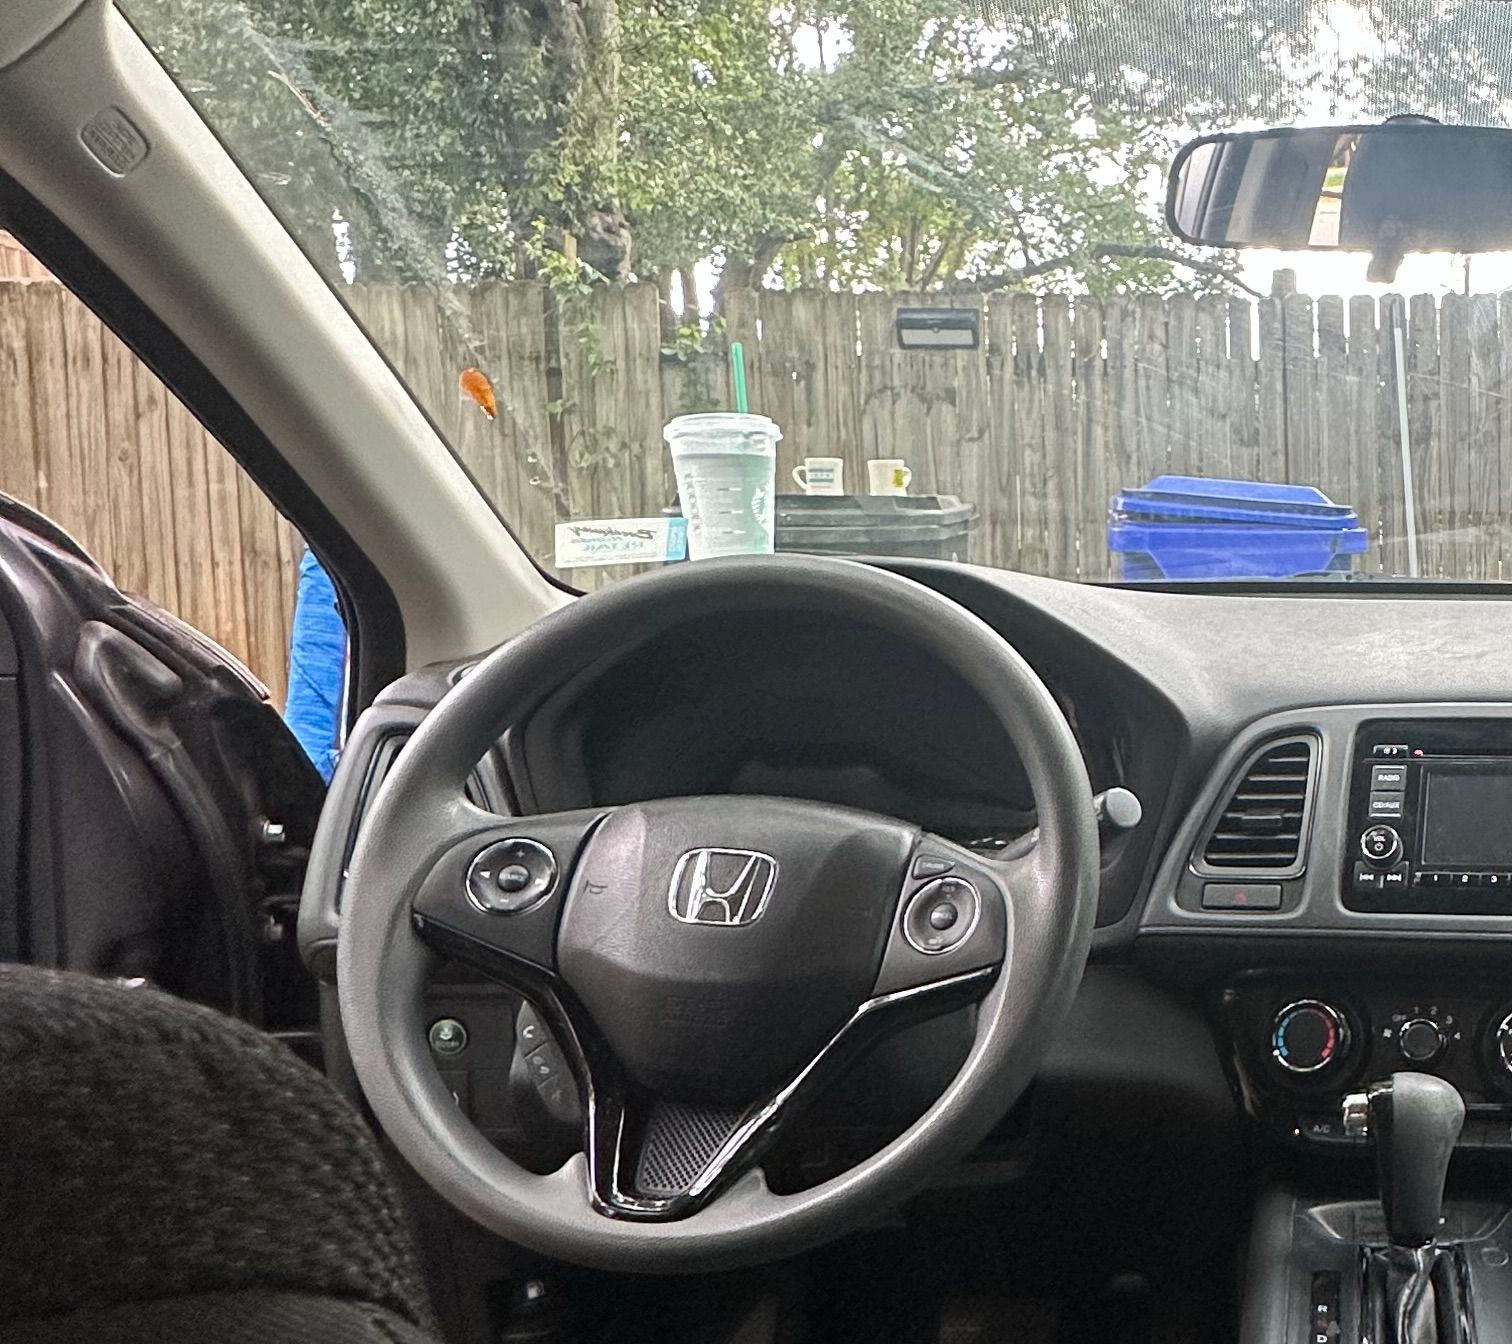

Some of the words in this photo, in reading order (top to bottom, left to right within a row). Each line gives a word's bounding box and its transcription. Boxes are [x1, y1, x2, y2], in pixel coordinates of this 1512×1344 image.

[1434, 874, 1439, 882] 1
[1461, 874, 1469, 883] 2
[1490, 875, 1498, 883] 3
[1414, 1005, 1419, 1014] 1
[1430, 1005, 1438, 1015] 2
[1445, 1015, 1453, 1025] 3
[1453, 1031, 1461, 1040] 4
[1312, 1124, 1330, 1133] A/C
[1317, 1304, 1328, 1313] R
[1316, 1334, 1328, 1343] D
